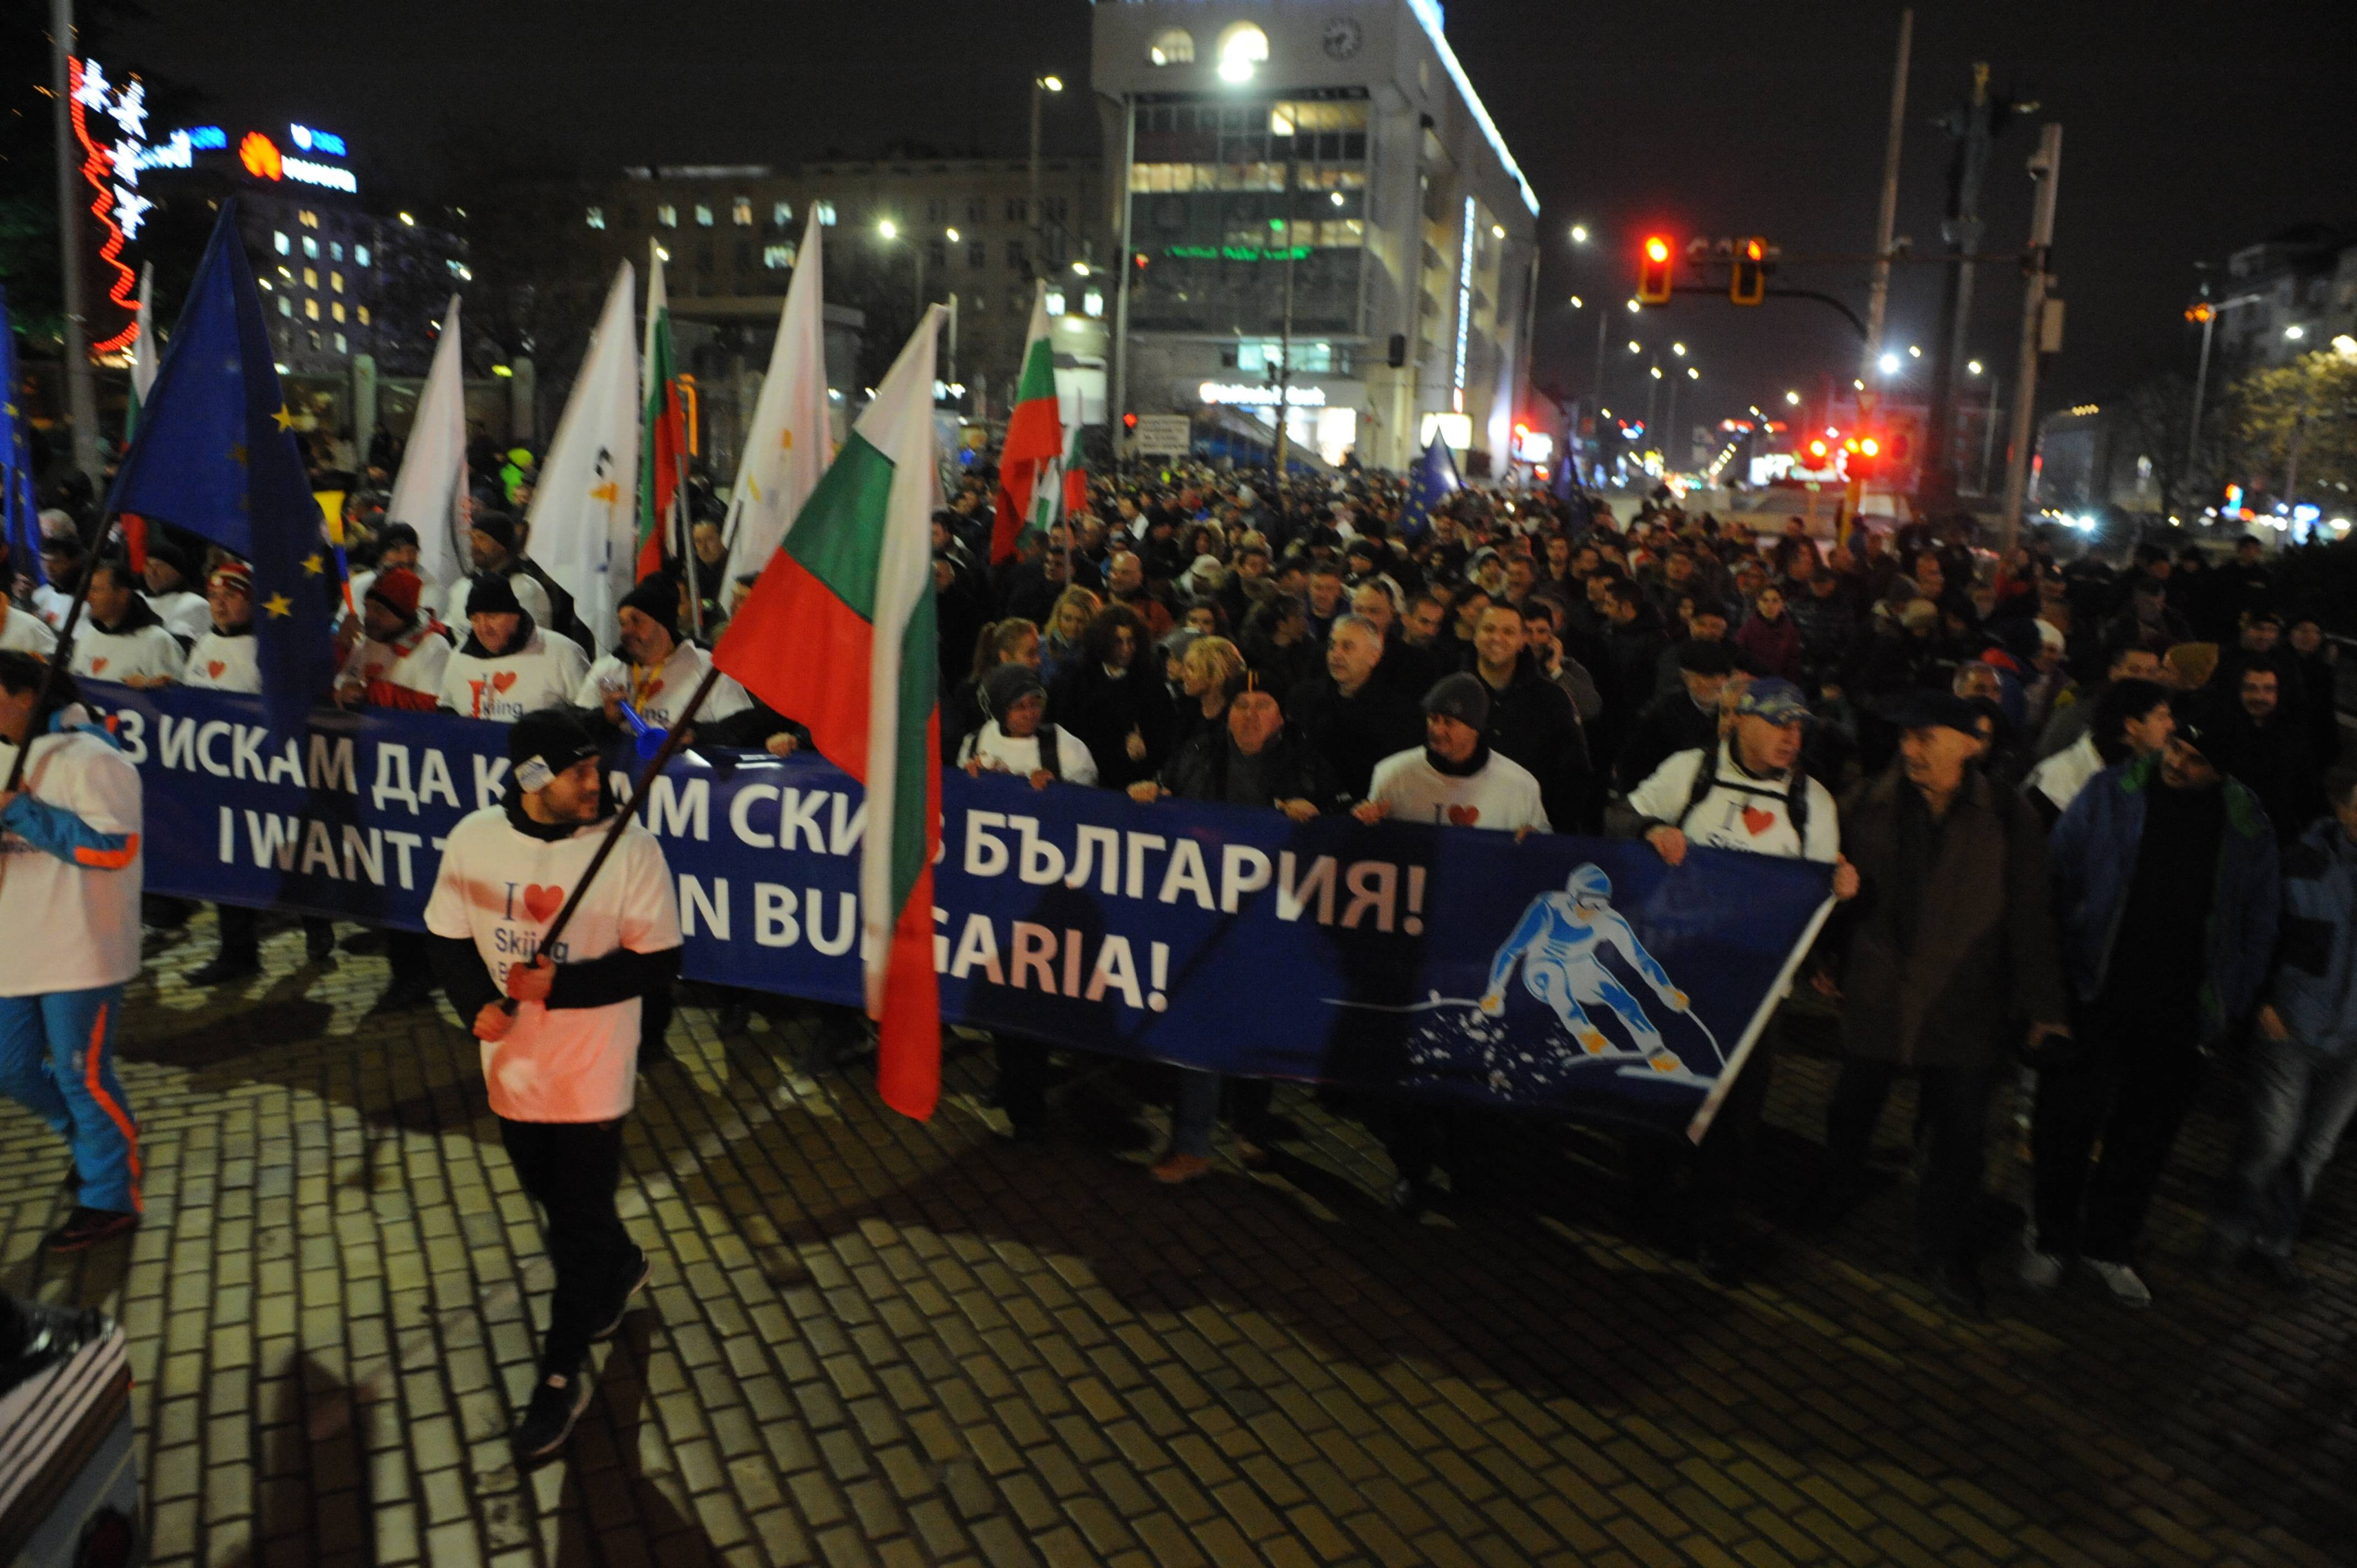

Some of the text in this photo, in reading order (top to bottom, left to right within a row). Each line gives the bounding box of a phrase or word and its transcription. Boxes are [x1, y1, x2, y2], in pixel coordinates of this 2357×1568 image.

[158, 714, 359, 795] ИСКАМ
[370, 741, 461, 816] ДА
[964, 808, 1427, 937] БЪЛГАРИЯ!
[218, 806, 234, 864] I
[244, 809, 423, 891] WANT
[502, 881, 518, 921] I
